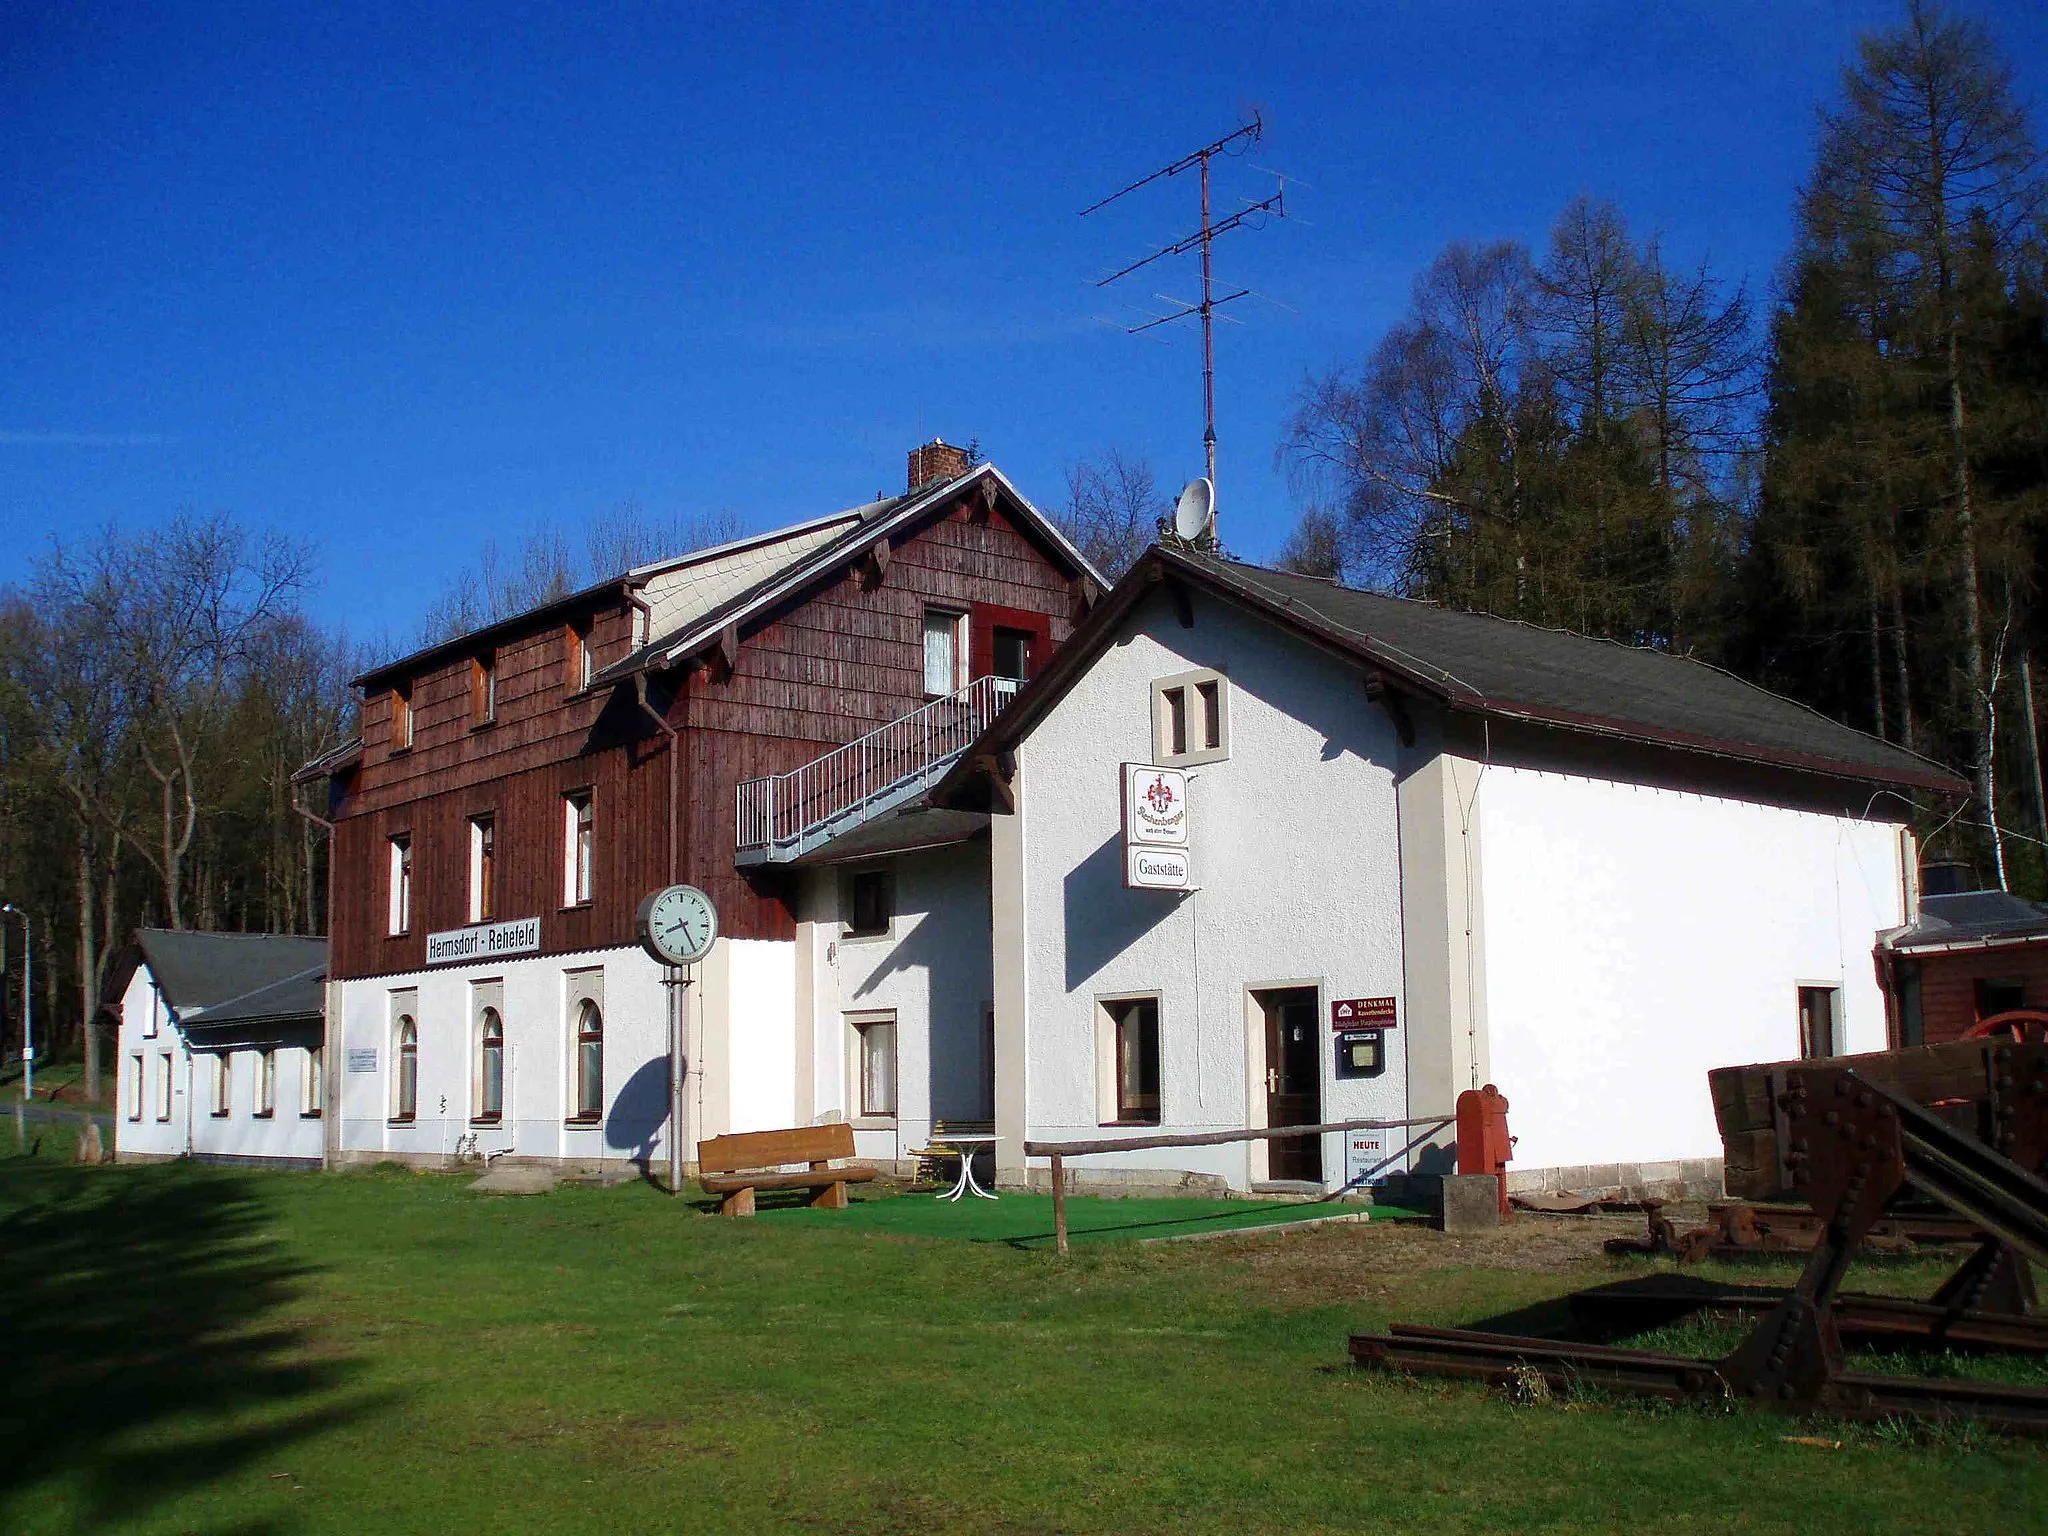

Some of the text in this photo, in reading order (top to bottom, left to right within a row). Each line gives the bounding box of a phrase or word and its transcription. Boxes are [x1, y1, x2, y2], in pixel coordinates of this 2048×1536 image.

[1139, 858, 1184, 877] Gaststätte
[429, 931, 478, 959] Hermsdorf
[488, 922, 535, 950] Rehefeld
[1357, 999, 1394, 1009] DENKMAL
[1353, 1141, 1380, 1150] HEUTE
